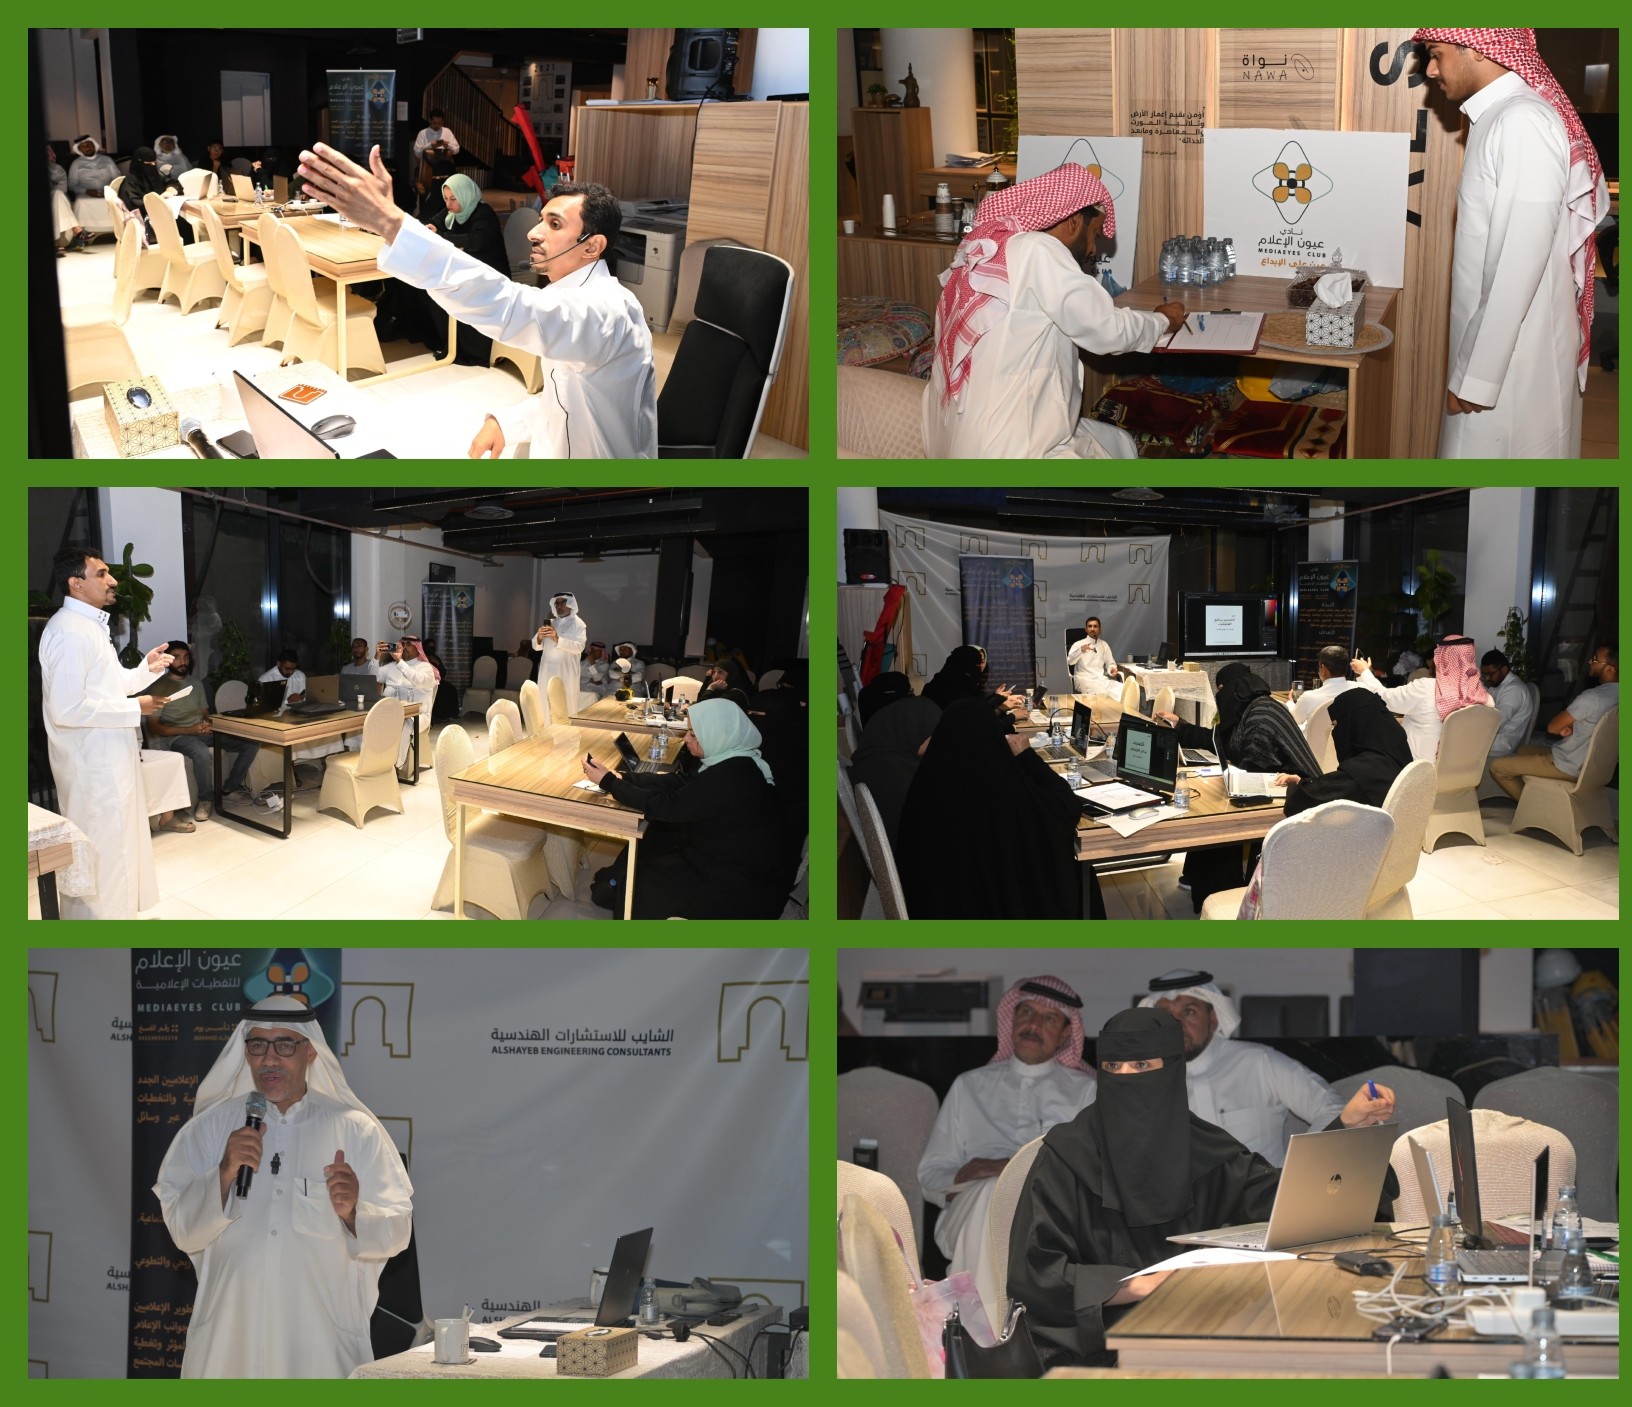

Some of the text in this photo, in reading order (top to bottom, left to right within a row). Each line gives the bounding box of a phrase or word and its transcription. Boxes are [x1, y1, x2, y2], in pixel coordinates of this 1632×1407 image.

[1243, 54, 1287, 69] نواة
[1243, 70, 1287, 81] NAWA
[1130, 110, 1148, 118] الأرض
[1280, 228, 1303, 236] نادي
[1258, 235, 1324, 250] عيون الإعلام
[1258, 248, 1301, 256] MEDIAEYES
[1260, 257, 1286, 267] الإبداع
[135, 949, 242, 975] عيون الإعلام
[136, 977, 241, 991] للتغطيات الإعلامية
[137, 1003, 241, 1013] MEDIAEYES CLUB
[491, 1027, 675, 1045] الشايب للاستشارات الهندسية
[491, 1046, 672, 1057] ALSHAYEB ENGINEERING CONSULTANTS
[137, 1074, 160, 1085] الجدد
[134, 1302, 170, 1315] الإعلاميين
[481, 1298, 541, 1313] الهندسية
[134, 1319, 161, 1331] الإعلام
[133, 1357, 165, 1369] المجتمع
